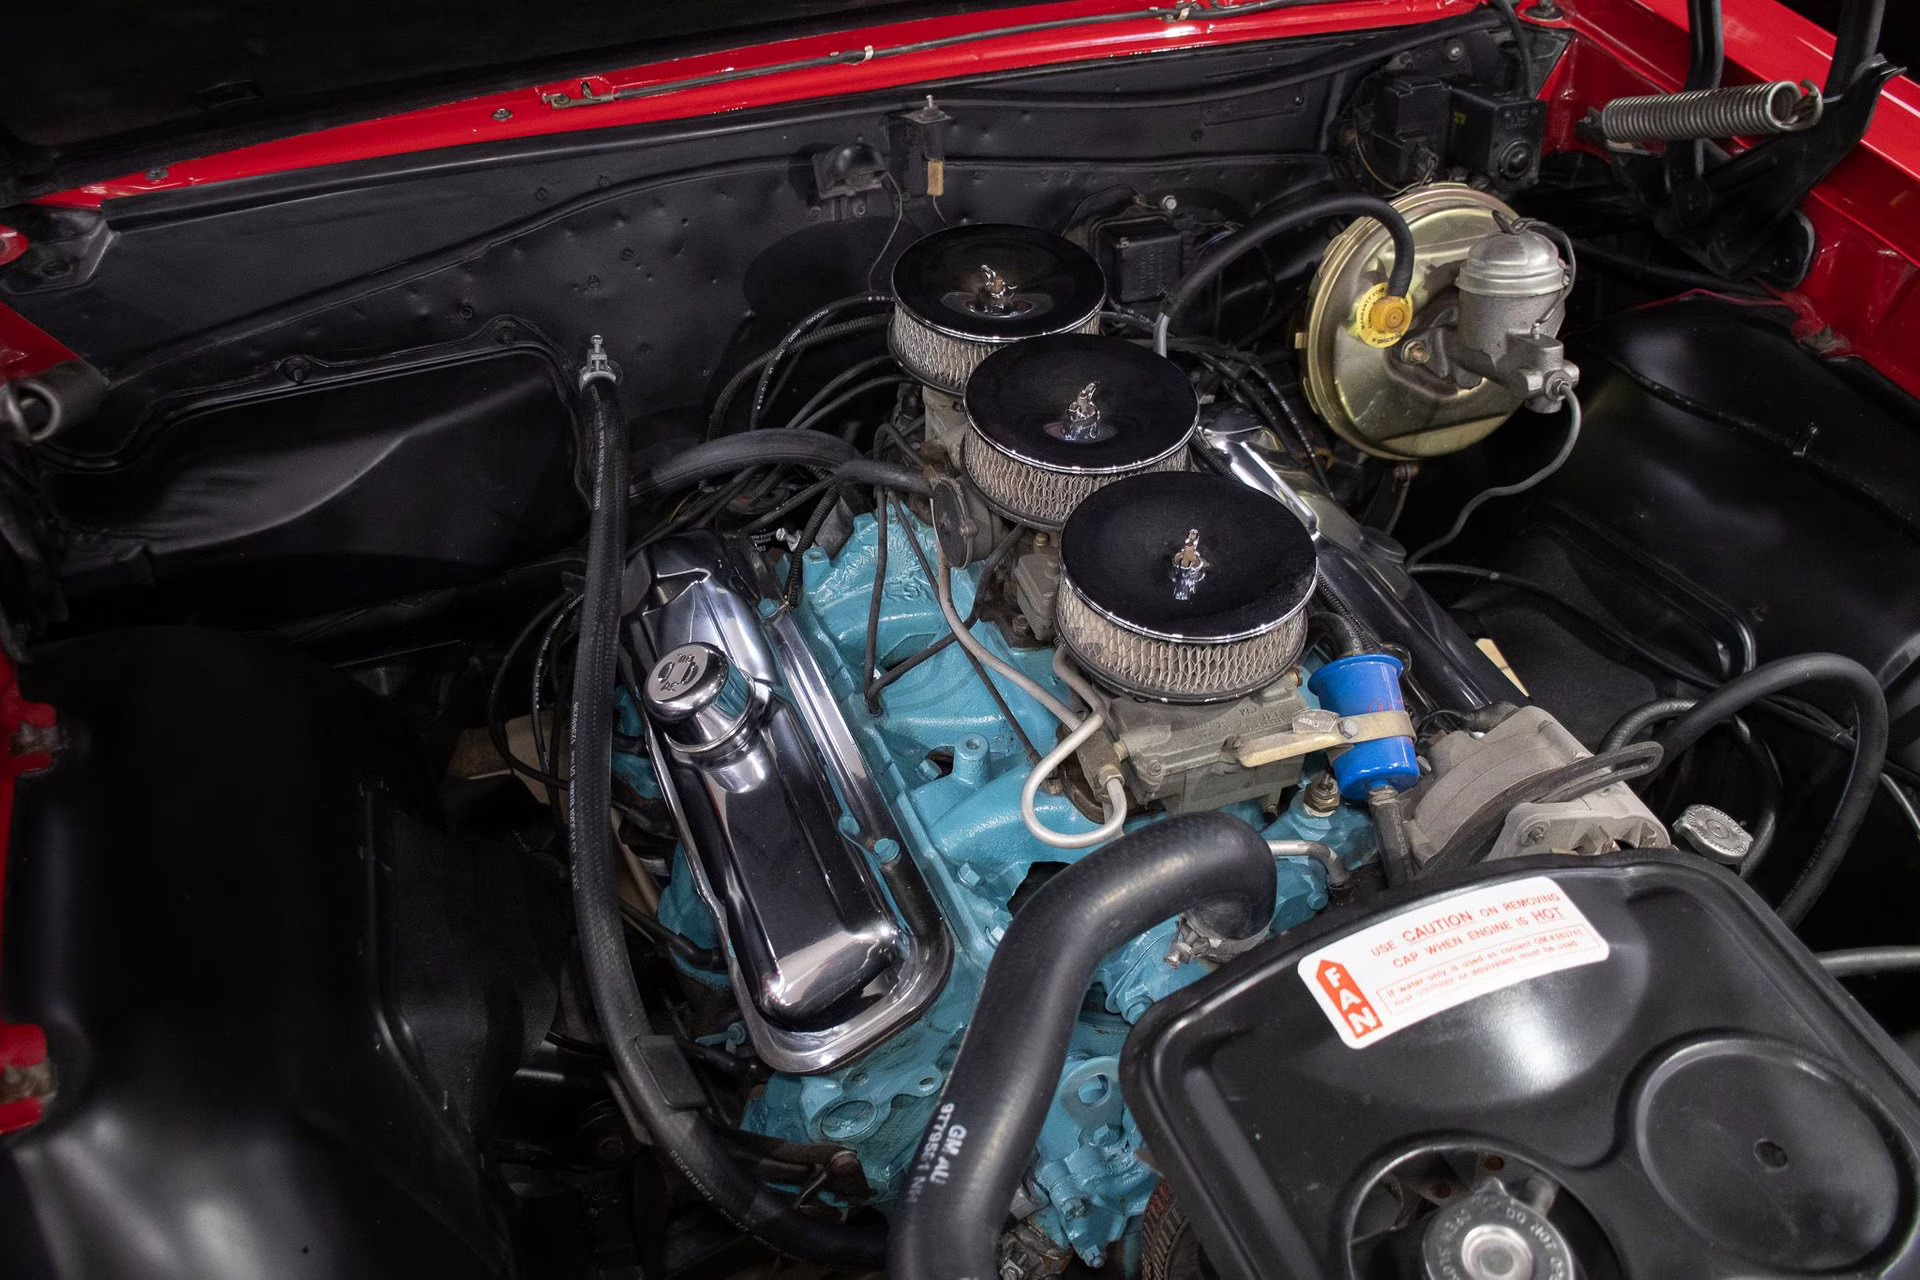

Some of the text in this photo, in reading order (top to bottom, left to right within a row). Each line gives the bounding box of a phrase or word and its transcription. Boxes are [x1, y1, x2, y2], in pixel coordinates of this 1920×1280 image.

[1370, 893, 1562, 957] USE CAUTION ON REMOVING
[1392, 906, 1562, 969] CAP WHEN ENGINE IS HOT
[1400, 978, 1425, 993] water
[1462, 955, 1483, 969] used
[1500, 941, 1532, 955] coolant
[1323, 966, 1378, 1032] FAN
[942, 1124, 968, 1157] GM
